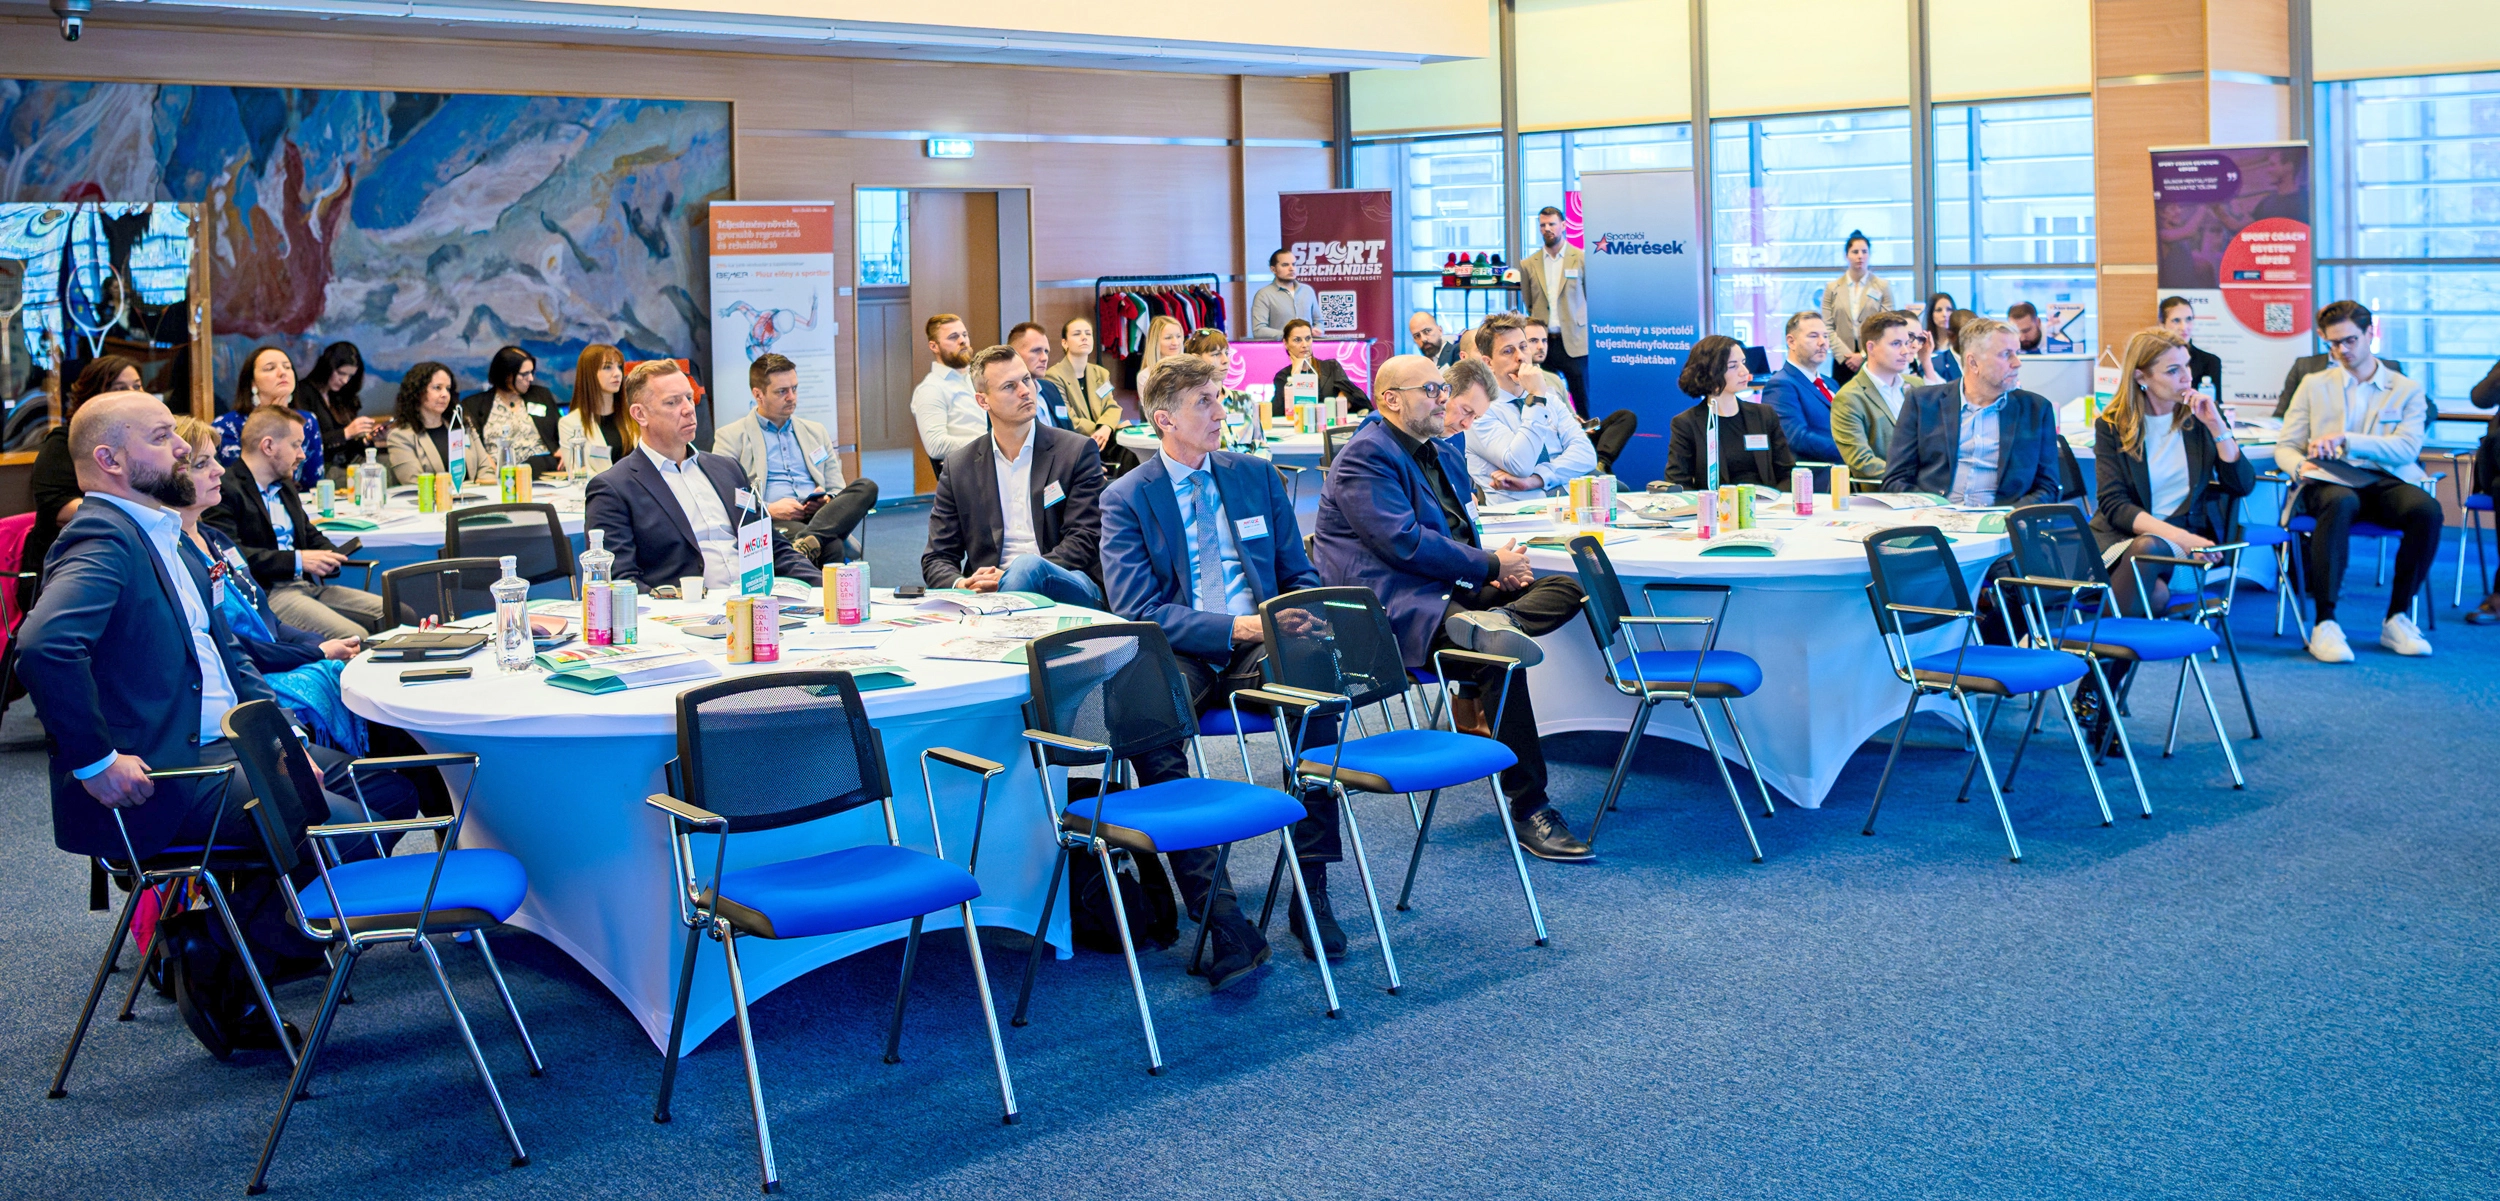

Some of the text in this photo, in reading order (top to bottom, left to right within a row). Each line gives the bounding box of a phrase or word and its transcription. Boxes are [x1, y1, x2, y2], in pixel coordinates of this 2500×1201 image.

[1606, 232, 1645, 241] Sportolói
[2241, 232, 2306, 242] SPORT COACH
[1291, 240, 1386, 266] SPORT
[1607, 239, 1684, 255] Mérések
[1591, 324, 1641, 336] Tudomány
[1650, 325, 1694, 336] sportolói
[1595, 338, 1690, 351] teljesítményfokozás
[1611, 353, 1676, 366] szolgálatában
